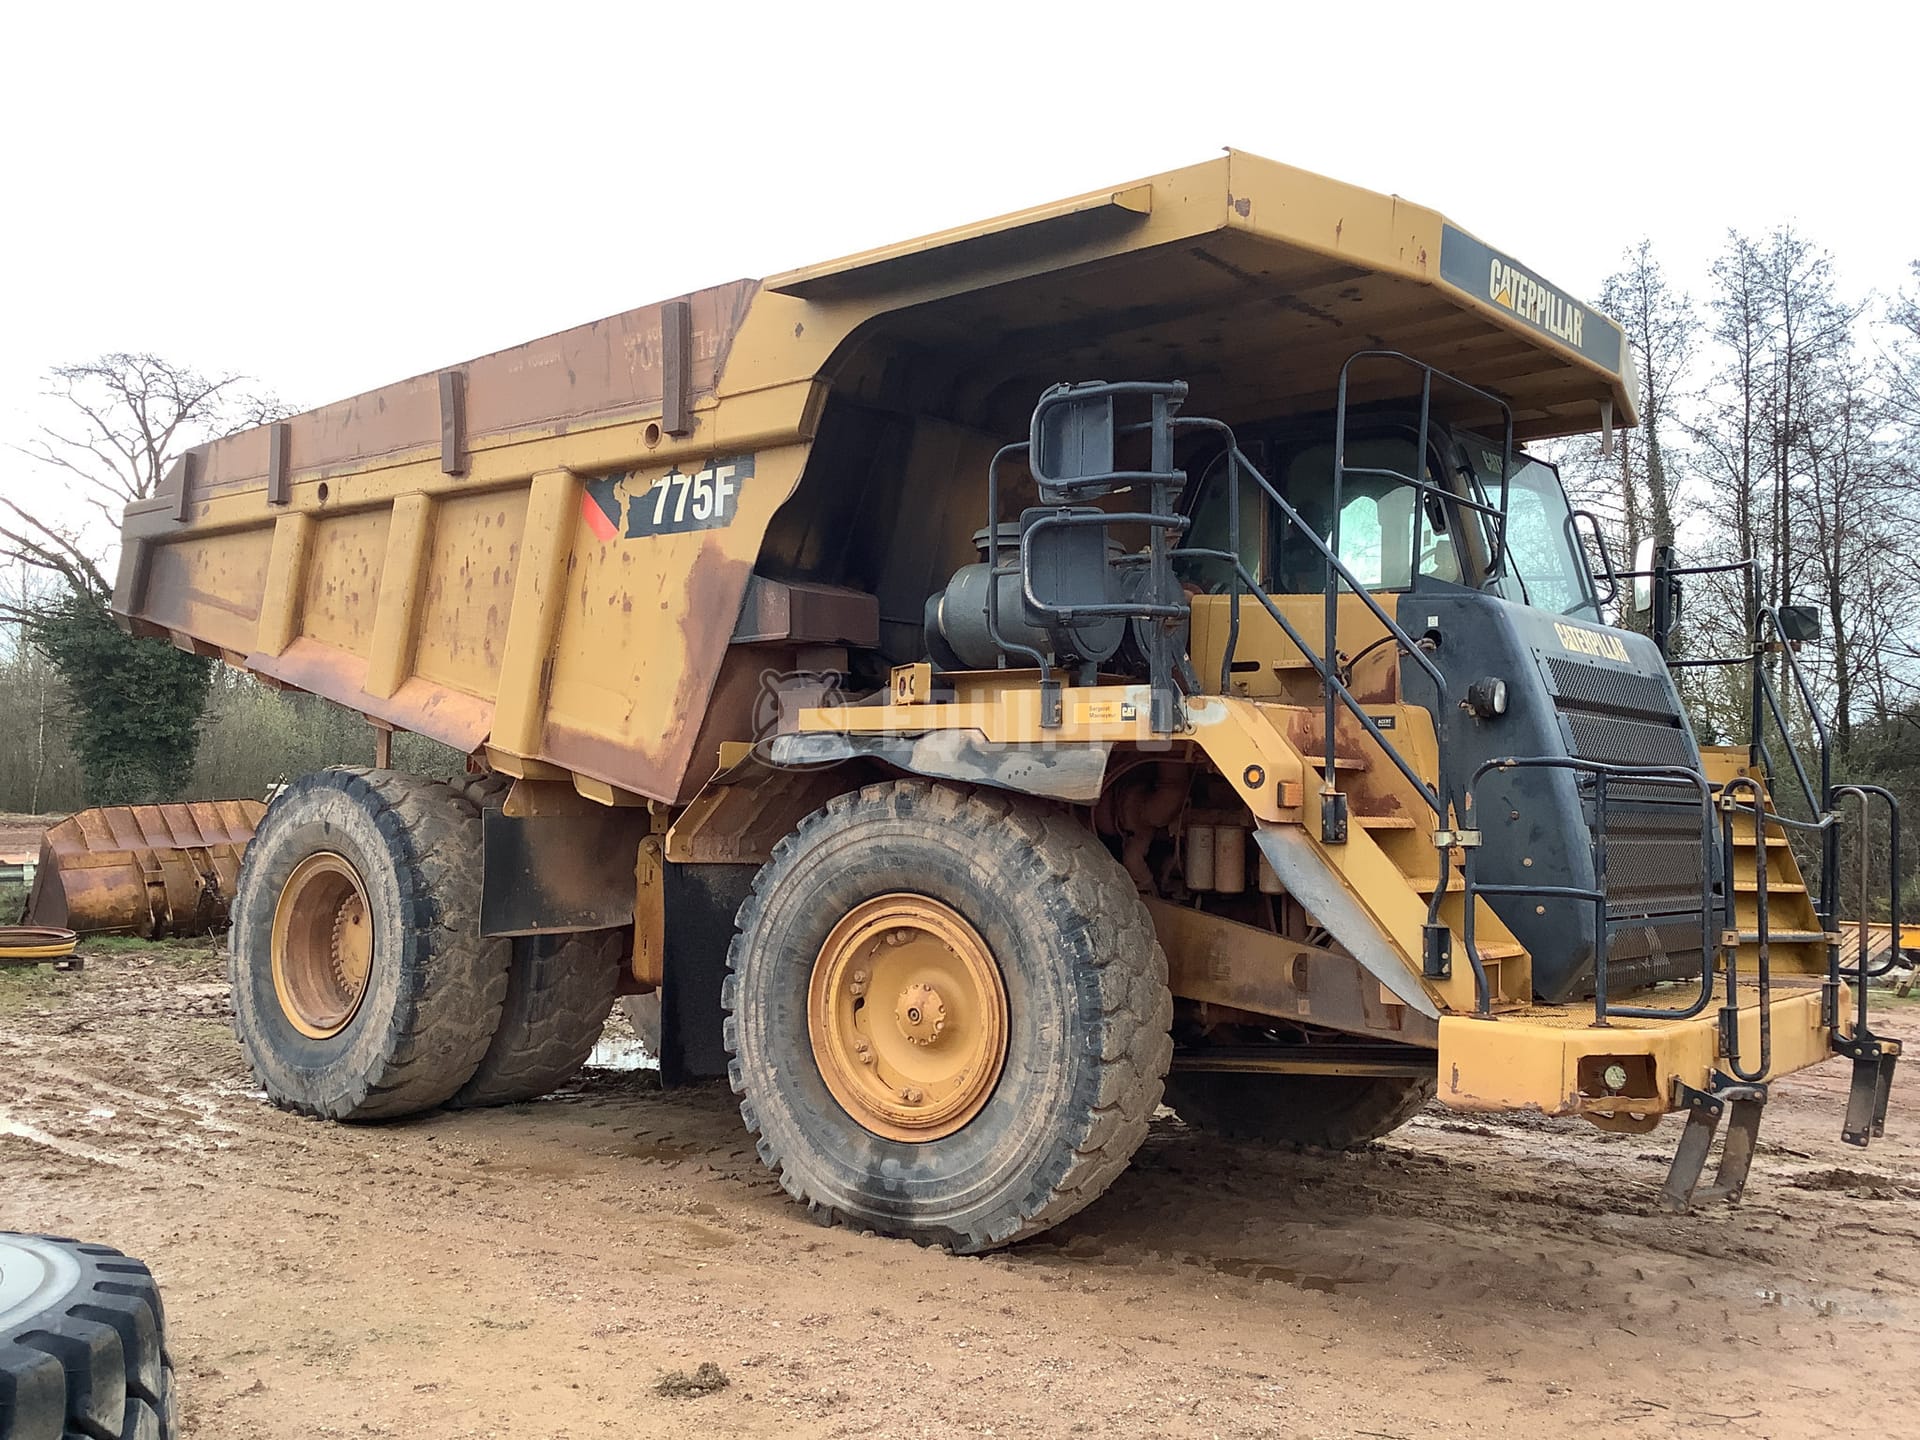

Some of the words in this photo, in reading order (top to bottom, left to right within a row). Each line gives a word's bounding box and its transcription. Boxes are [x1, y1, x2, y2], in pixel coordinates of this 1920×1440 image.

[1489, 258, 1584, 348] CATERPILLAR
[652, 464, 736, 525] 775F
[1553, 622, 1631, 663] CATERPILLAR
